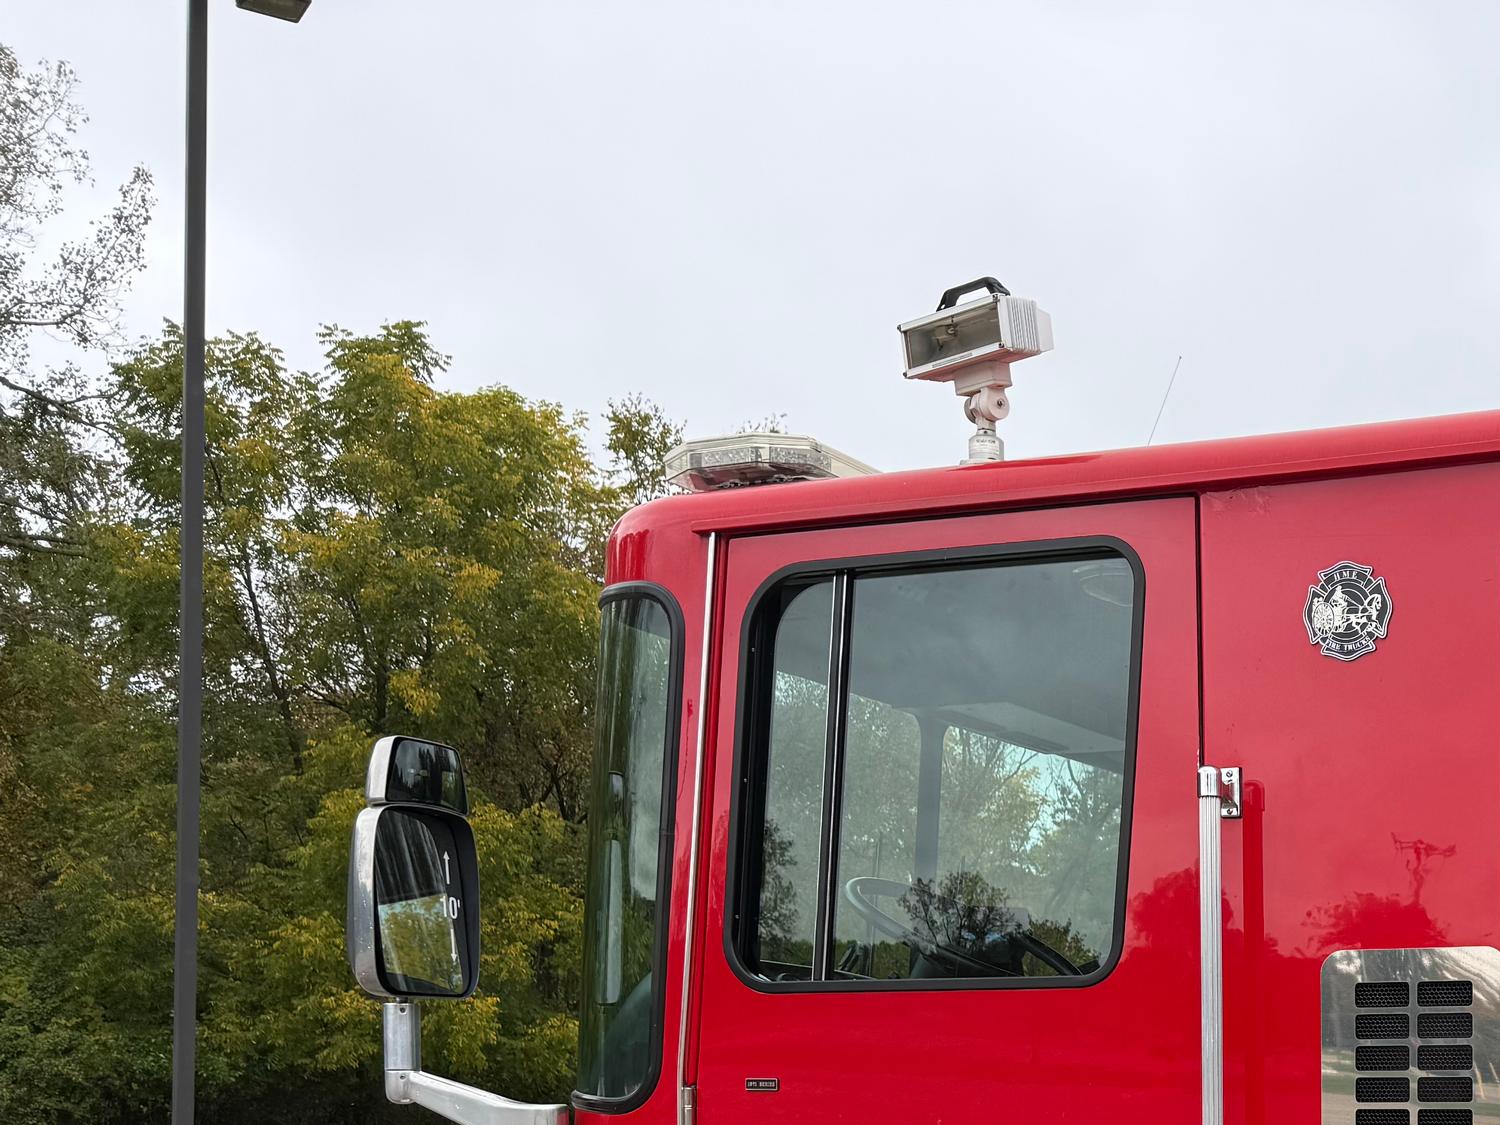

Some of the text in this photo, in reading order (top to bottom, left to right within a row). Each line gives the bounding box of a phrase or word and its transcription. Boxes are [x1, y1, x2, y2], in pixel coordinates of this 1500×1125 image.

[1333, 571, 1358, 580] HME
[1325, 635, 1371, 651] FIRE TRUCKS
